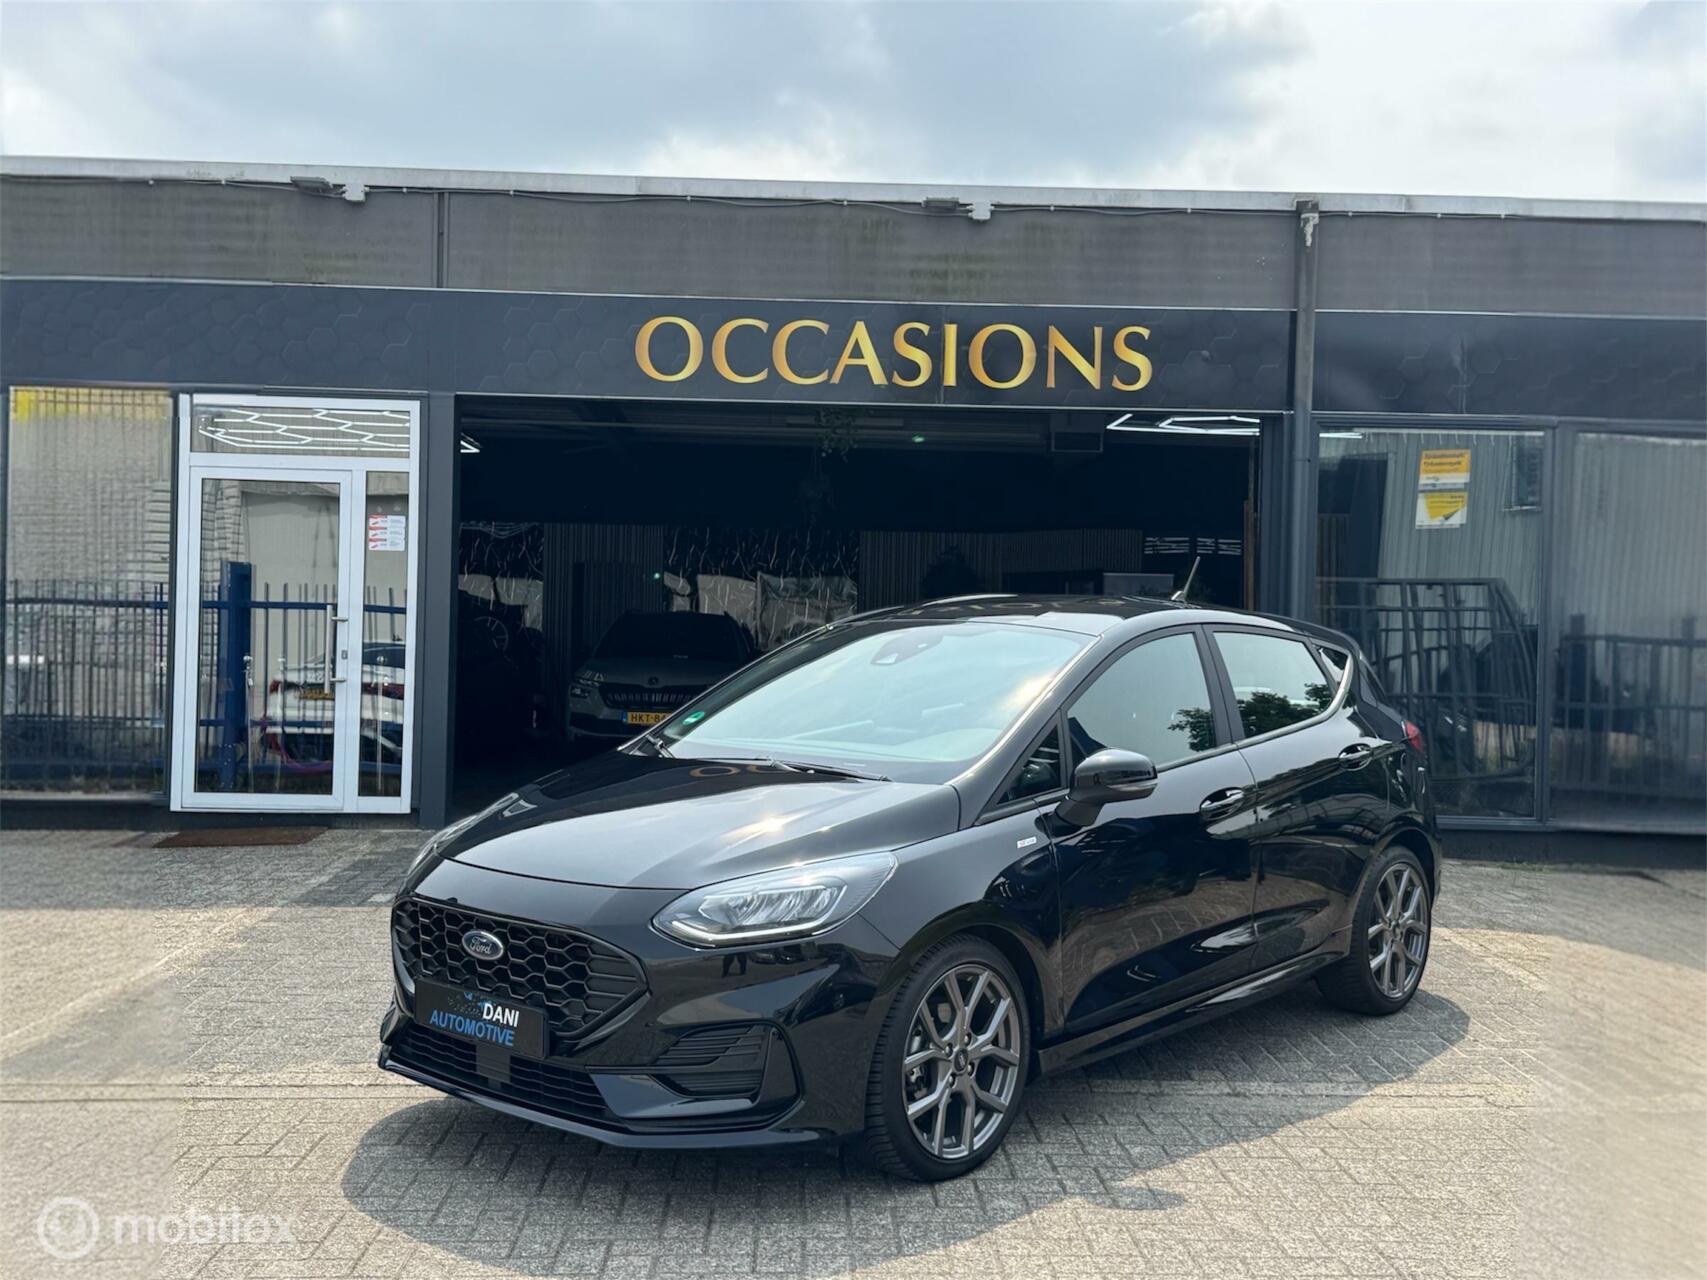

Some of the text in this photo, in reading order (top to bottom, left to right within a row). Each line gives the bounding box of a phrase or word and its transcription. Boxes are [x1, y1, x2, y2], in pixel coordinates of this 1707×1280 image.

[635, 316, 1153, 391] OCCASIONS
[470, 936, 492, 954] Ford
[430, 1009, 514, 1046] AUTOMOTIVE
[482, 1002, 519, 1027] DANI
